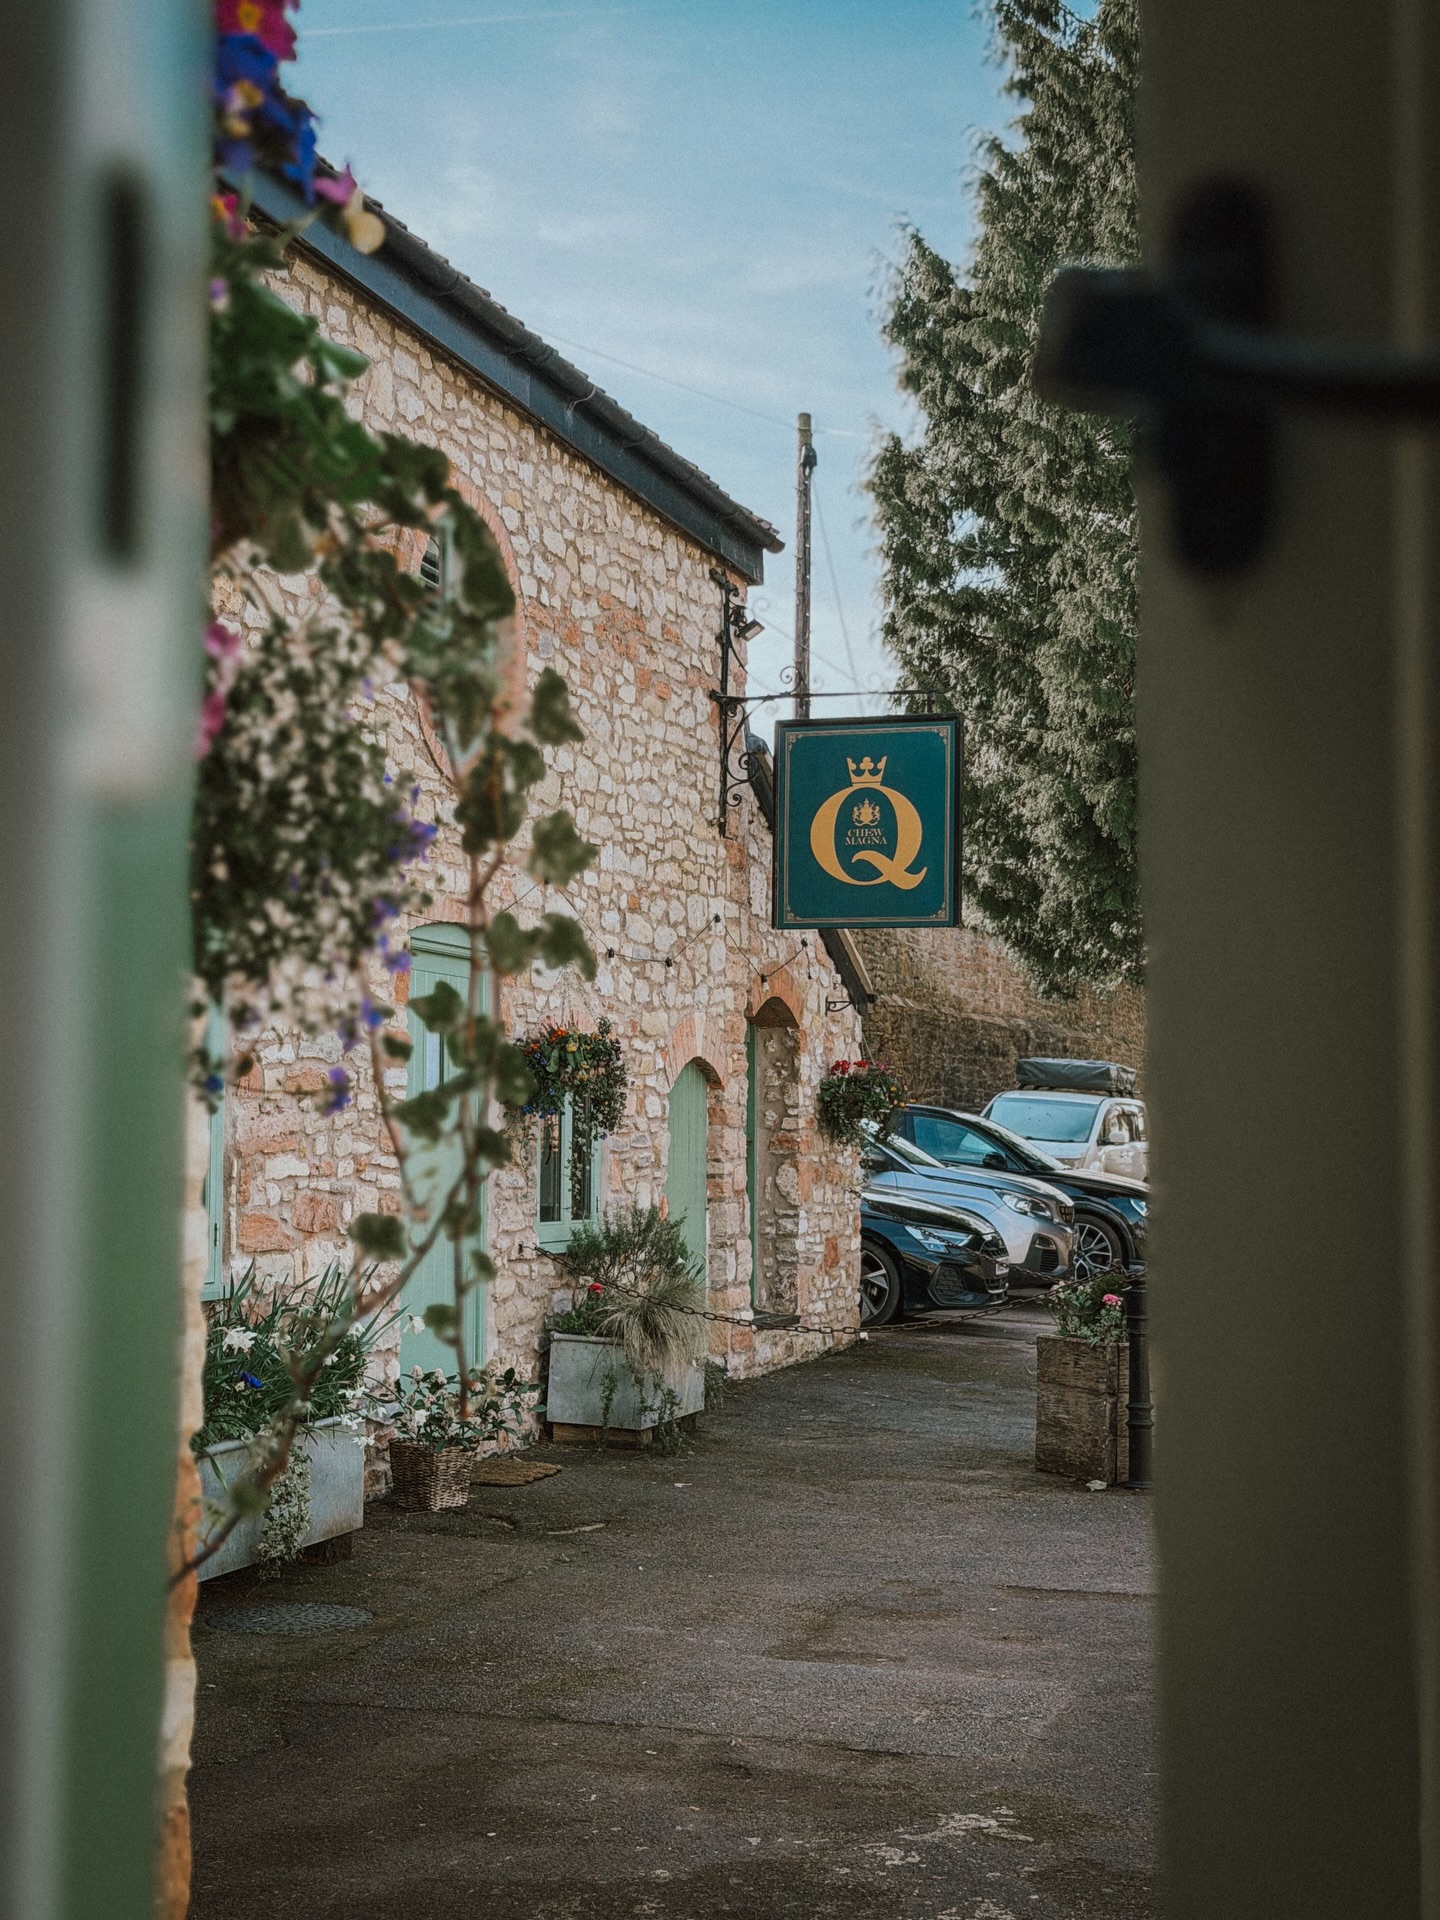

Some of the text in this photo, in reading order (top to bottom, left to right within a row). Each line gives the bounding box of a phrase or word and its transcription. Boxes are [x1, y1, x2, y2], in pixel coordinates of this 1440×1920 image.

[847, 828, 884, 837] CHEW
[810, 785, 928, 890] Q
[845, 836, 888, 845] MAGNA
